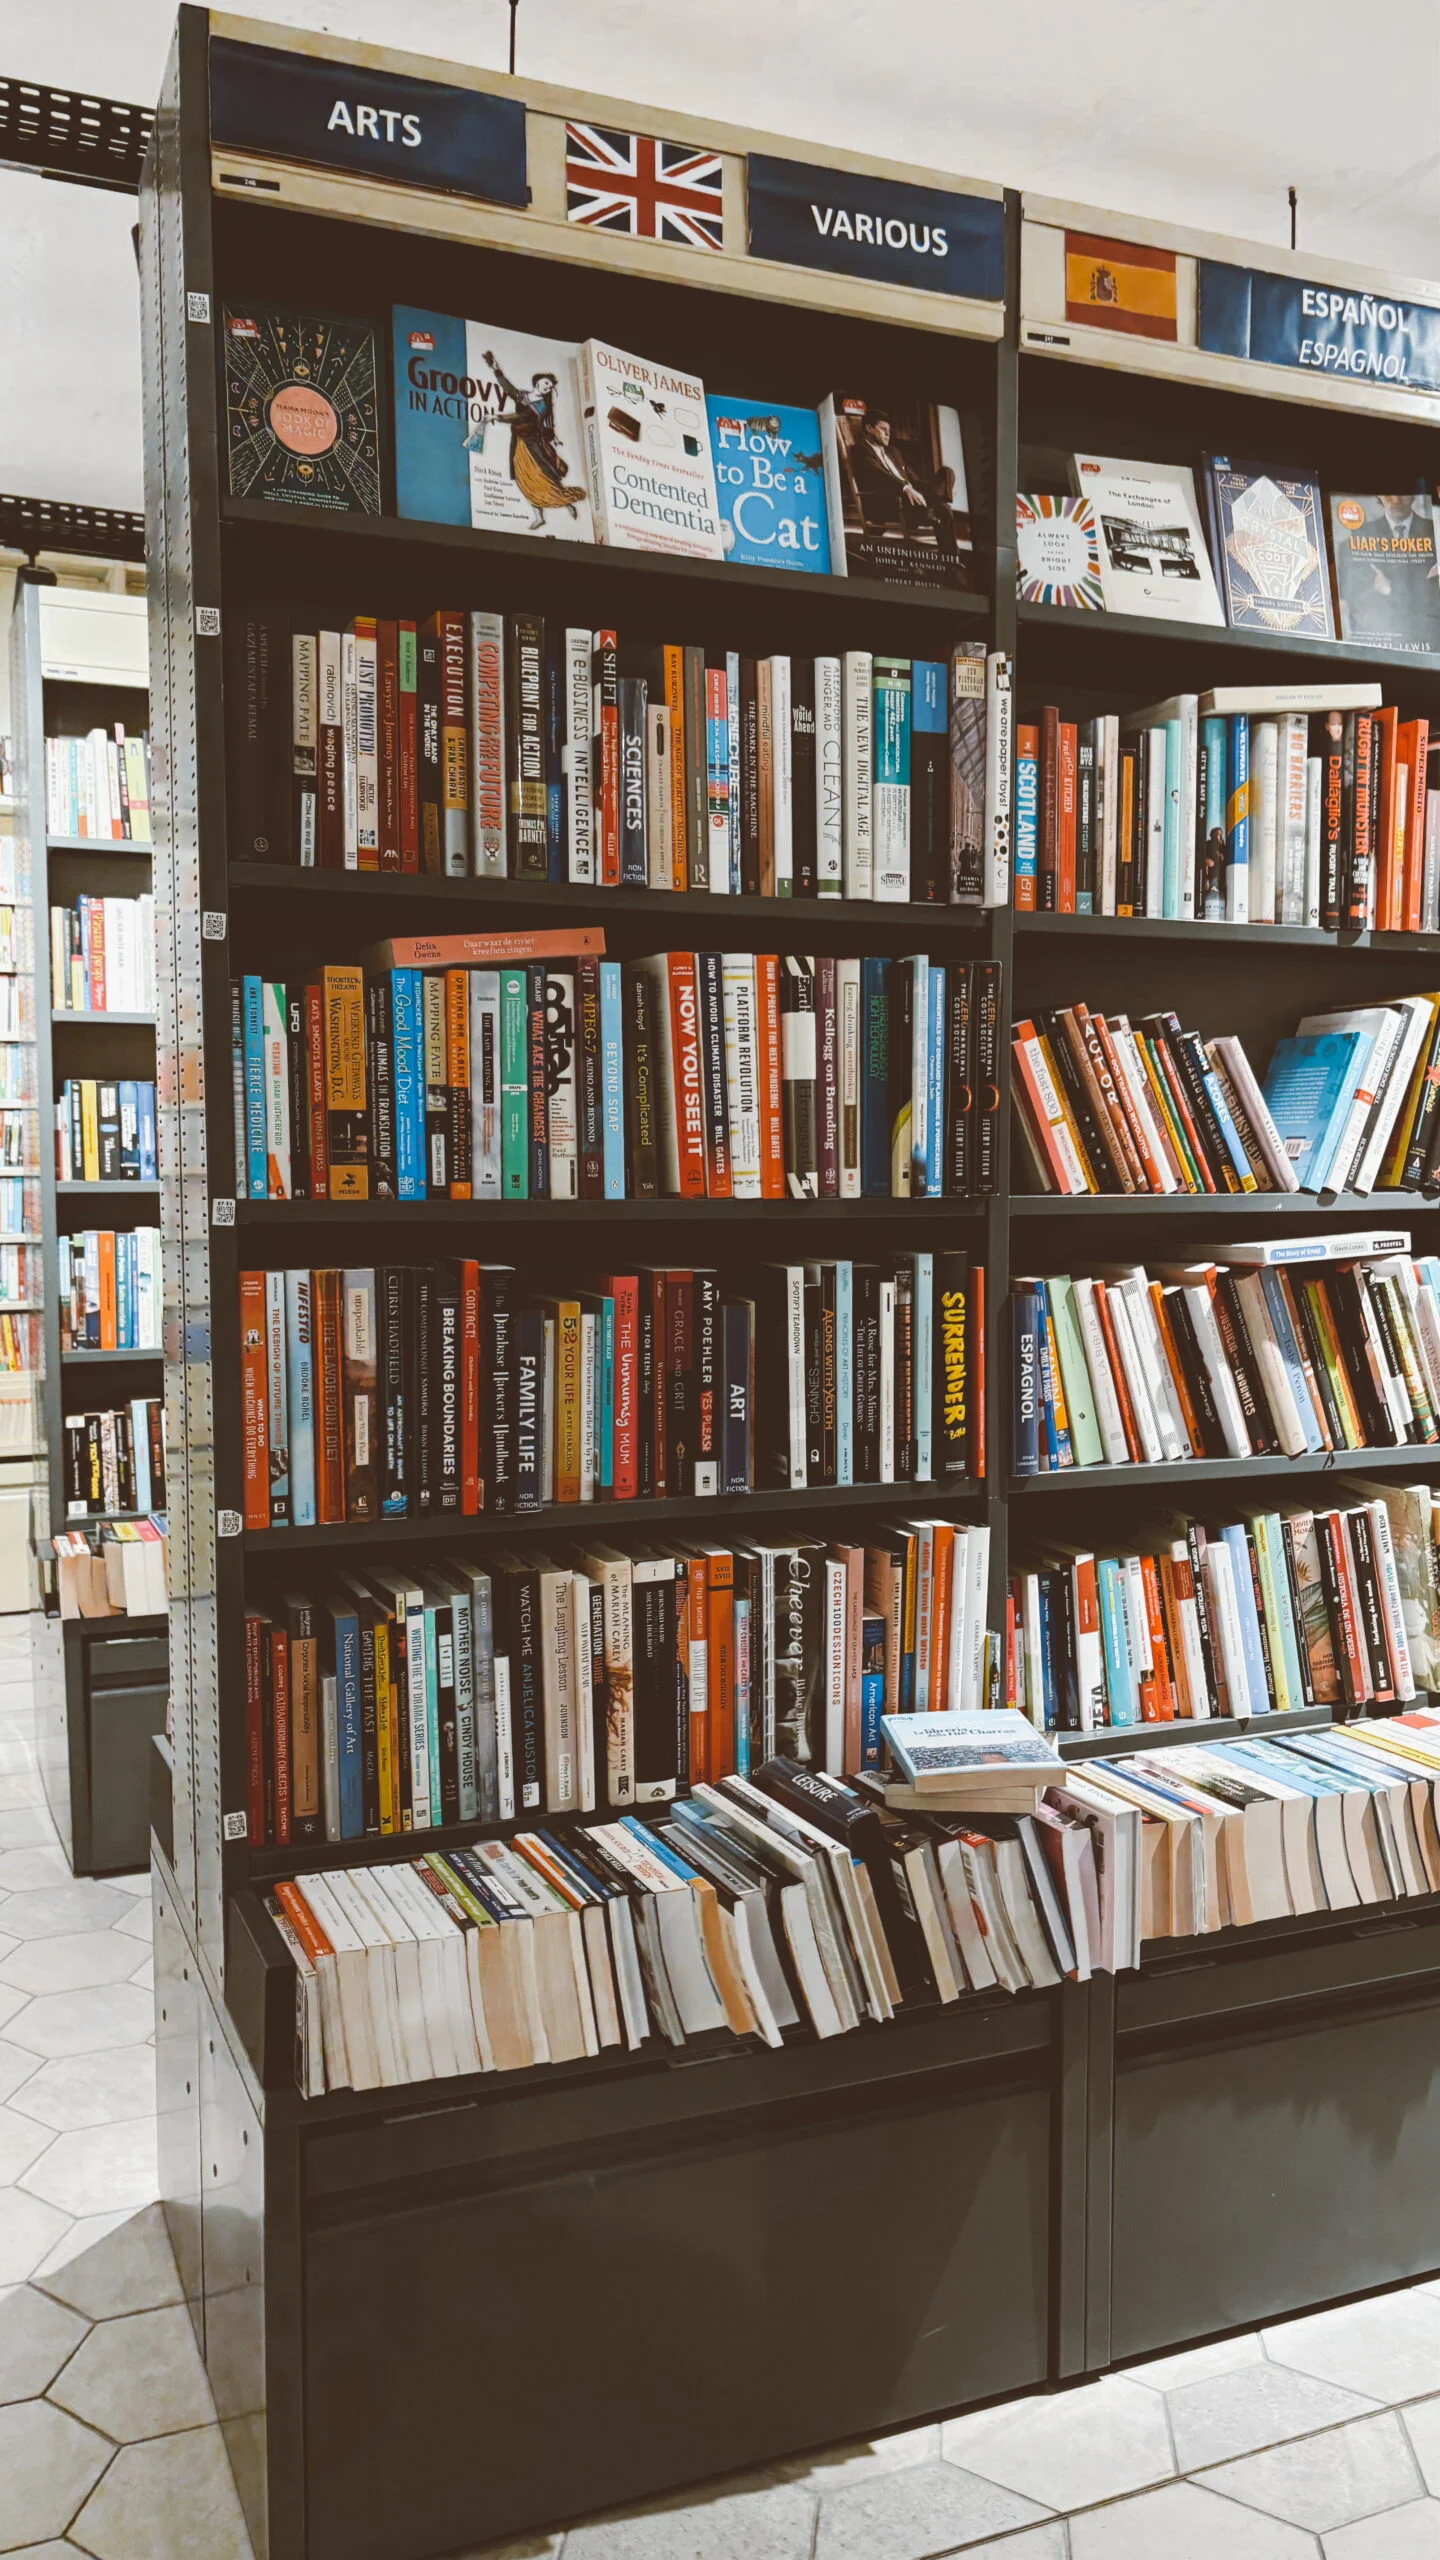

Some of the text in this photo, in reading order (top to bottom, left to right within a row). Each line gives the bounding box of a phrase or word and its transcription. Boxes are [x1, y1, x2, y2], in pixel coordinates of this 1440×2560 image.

[327, 101, 422, 147] ARTS
[810, 204, 949, 258] VARIOUS
[1302, 287, 1410, 335] ESPAÑOL
[408, 356, 510, 411] Groovy
[596, 351, 701, 401] OLIVER JAMES
[1299, 338, 1409, 382] ESPAGNOL
[409, 390, 495, 426] IN ACTION
[716, 416, 793, 458] How
[613, 465, 710, 510] Contented
[716, 455, 808, 495] to Be a
[1127, 499, 1154, 509] London
[611, 486, 716, 536] Dementia
[733, 491, 819, 551] Cat
[1037, 532, 1070, 540] ALWAYS
[1240, 515, 1300, 552] CRYSTAL
[1350, 535, 1433, 552] LIAR'S POKER
[877, 545, 938, 561] UNFINISHED
[1258, 551, 1288, 564] CODE
[299, 640, 310, 741] MAPPING FATE
[326, 664, 337, 721] rabinovich
[445, 623, 464, 717] EXECUTION
[603, 652, 617, 705] SHIFT
[358, 656, 376, 757] JUST PROMOTED!
[521, 646, 541, 778] BLUEPRINT FOR ACTION
[761, 704, 771, 772] mindful eating
[792, 708, 812, 722] World
[794, 721, 815, 734] Ahead
[1357, 717, 1372, 761] RUGBY
[325, 728, 337, 812] waging peace
[573, 659, 589, 857] e-BUSINESS INTELLIGENCE
[626, 734, 642, 831] SCIENCES
[823, 741, 841, 827] CLEAN
[856, 696, 870, 837] THE NEW DIGITAL AGE
[1288, 732, 1304, 820] NO BARRIERS
[1357, 768, 1370, 785] IN
[1017, 762, 1037, 860] SCOTLAND
[1325, 755, 1342, 904] Dallaglio's RUGBY TALES
[1355, 787, 1370, 856] MUNSTER
[290, 1002, 300, 1032] UFO
[350, 1000, 361, 1100] WEEKEND GETAWAYS
[395, 977, 412, 1105] The Good Mood Diet
[429, 981, 441, 1079] MAPPING FATE
[736, 986, 753, 1114] PLATFORM REVOLUTION
[607, 1042, 619, 1132] BEYOND SOAP
[636, 1044, 652, 1146] It's Complicated
[679, 985, 702, 1158] NOW YOU SEE IT
[823, 1008, 836, 1150] Kellogg on Branding
[1084, 1022, 1119, 1106] ACTOR
[249, 1057, 263, 1153] FIERCE MEDICINE
[1111, 1059, 1150, 1161] DOG TRAINING REVOLUTION
[1205, 1076, 1231, 1124] AZORES
[714, 1125, 725, 1175] BILL GATES
[297, 1280, 310, 1345] INFESTED
[351, 1294, 363, 1355] unspeakable
[388, 1275, 400, 1384] CHRIS HADFIELD
[702, 1280, 713, 1384] AMY POEHLER
[442, 1307, 456, 1476] BREAKING BOUNDARIES
[563, 1317, 577, 1405] 5:2 YOUR LIFE
[616, 1322, 635, 1465] THE Unmumsy MUM
[822, 1308, 835, 1431] ALONG WITH YOUTH
[941, 1291, 966, 1425] SURRENDER
[1020, 1333, 1034, 1423] ESPAGNOL
[518, 1356, 536, 1473] FAMILY LIFE
[729, 1383, 746, 1421] ART
[1293, 1518, 1313, 1530] JAVIER
[520, 1585, 532, 1656] WATCH ME
[555, 1582, 568, 1692] The Laughing Lesson
[592, 1594, 603, 1655] GENERATION
[622, 1602, 630, 1650] MEANING
[788, 1557, 812, 1671] Cheever
[1336, 1572, 1356, 1659] HISTORIA DE UN DESEO
[458, 1607, 471, 1694] MOTHER NOISE
[344, 1632, 356, 1754] National Gallery of Art
[522, 1664, 536, 1784] ANJELICA HUSTON
[560, 1703, 569, 1739] JOHNSON
[868, 1681, 878, 1742] American Art
[461, 1716, 474, 1788] CINDY HOUSE
[791, 1773, 839, 1803] LEISURE
